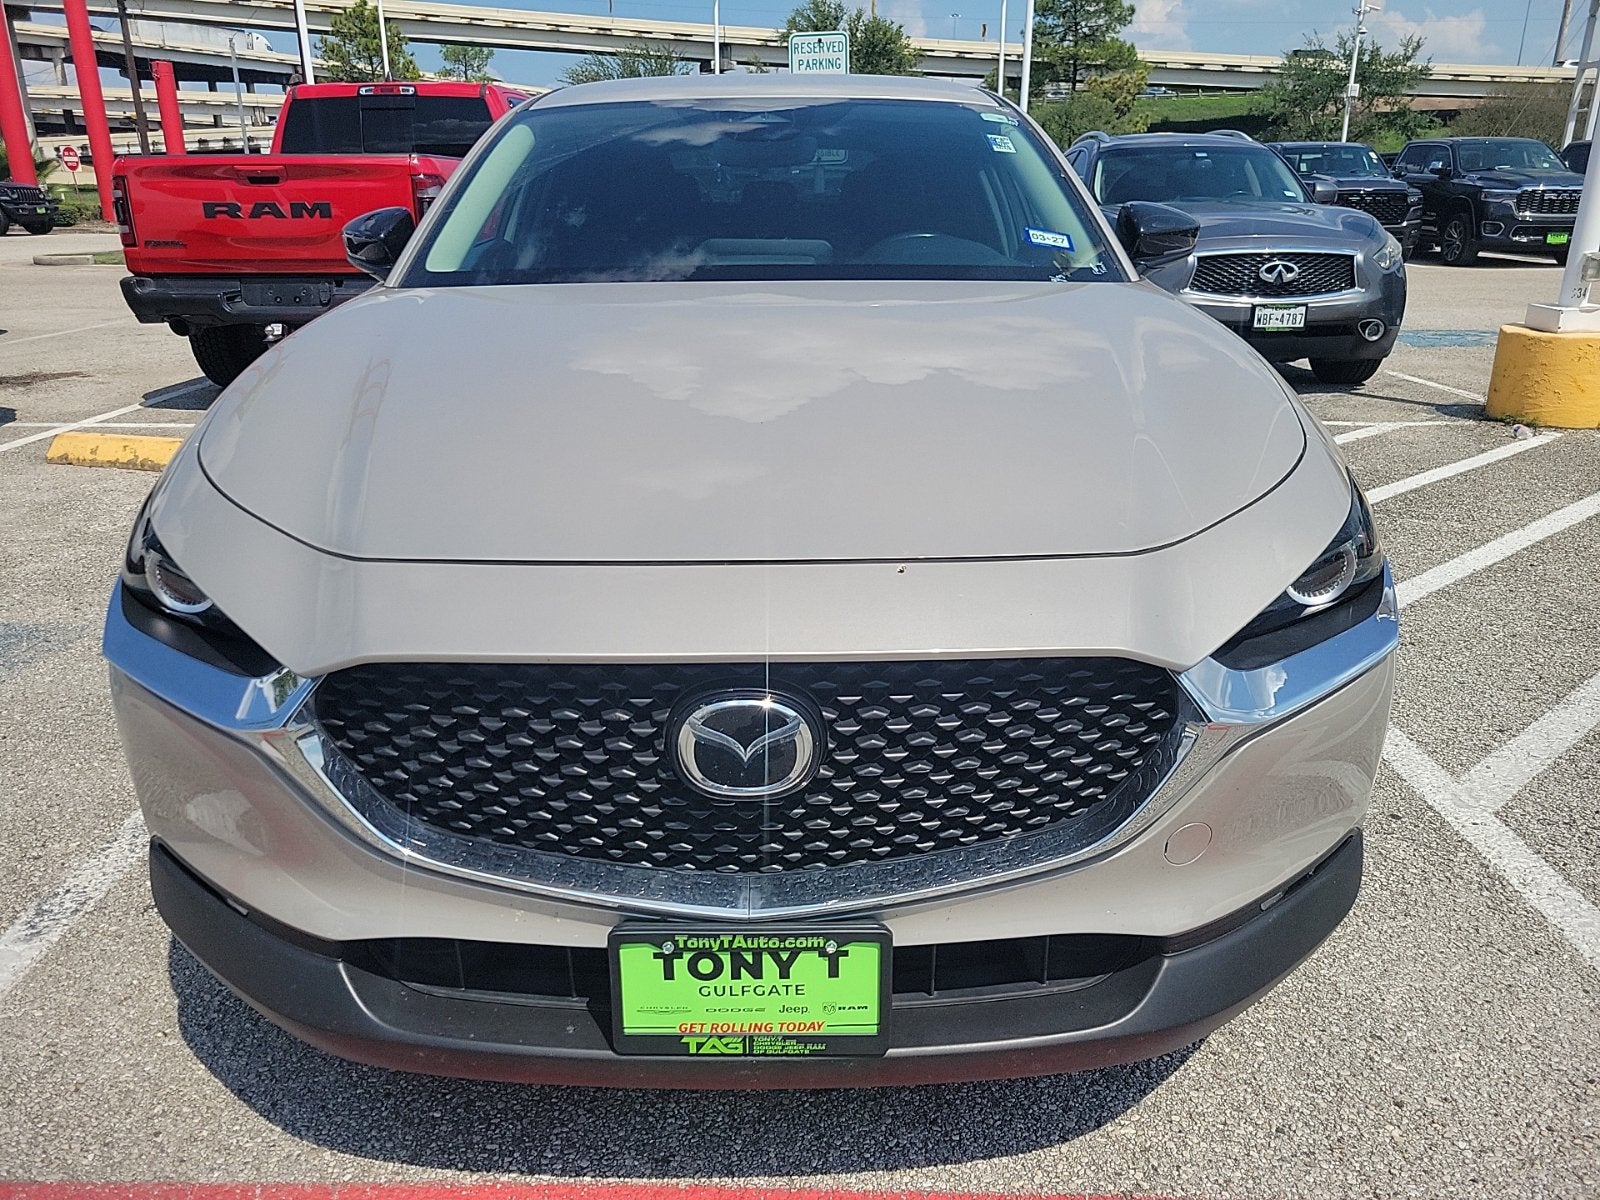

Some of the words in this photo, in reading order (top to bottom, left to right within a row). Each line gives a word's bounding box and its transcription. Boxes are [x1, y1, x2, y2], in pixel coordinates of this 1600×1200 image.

[793, 40, 844, 55] RESERVED
[798, 57, 841, 71] PARKING
[202, 202, 332, 219] RAM
[674, 935, 826, 952] TonyTAuto.com
[652, 951, 803, 981] TONY
[819, 949, 849, 979] T
[698, 984, 806, 998] GULFGATE
[778, 1004, 809, 1015] Jeep
[678, 1023, 708, 1034] GET
[709, 1022, 774, 1034] ROLLING
[778, 1021, 826, 1032] TODAY
[680, 1035, 744, 1054] TAG
